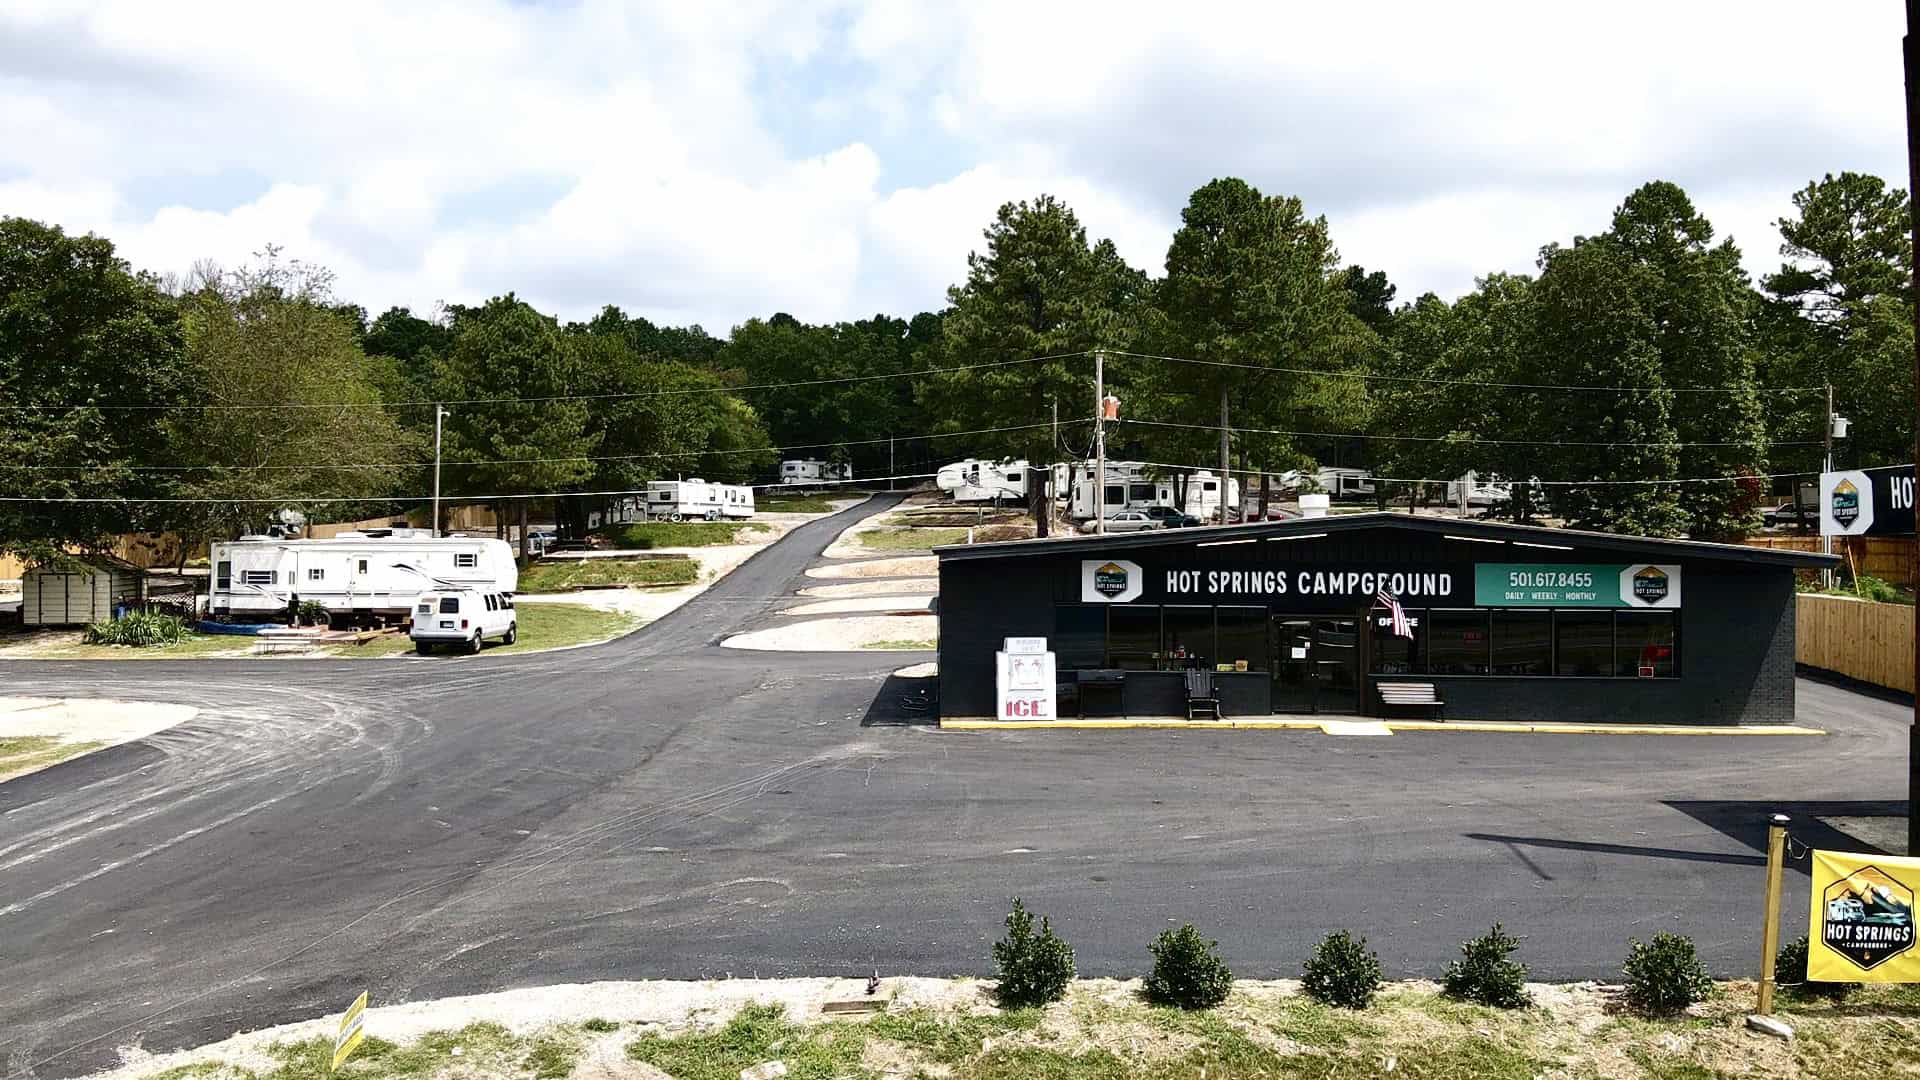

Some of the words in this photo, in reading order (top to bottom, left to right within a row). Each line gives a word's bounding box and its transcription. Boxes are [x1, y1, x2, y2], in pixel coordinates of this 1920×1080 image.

[1890, 476, 1916, 509] HO
[1166, 570, 1201, 593] HOT
[1208, 570, 1288, 594] SPRINGS
[1297, 571, 1452, 596] CAMPGROUND
[1509, 572, 1592, 587] 501.617.8455
[1505, 591, 1524, 600] DAILY
[1531, 591, 1557, 600] WEEKLY
[1565, 591, 1596, 600] MONTHLY
[1005, 697, 1048, 717] ICE
[1827, 923, 1852, 940] HOT
[1855, 925, 1911, 942] SPRINGS
